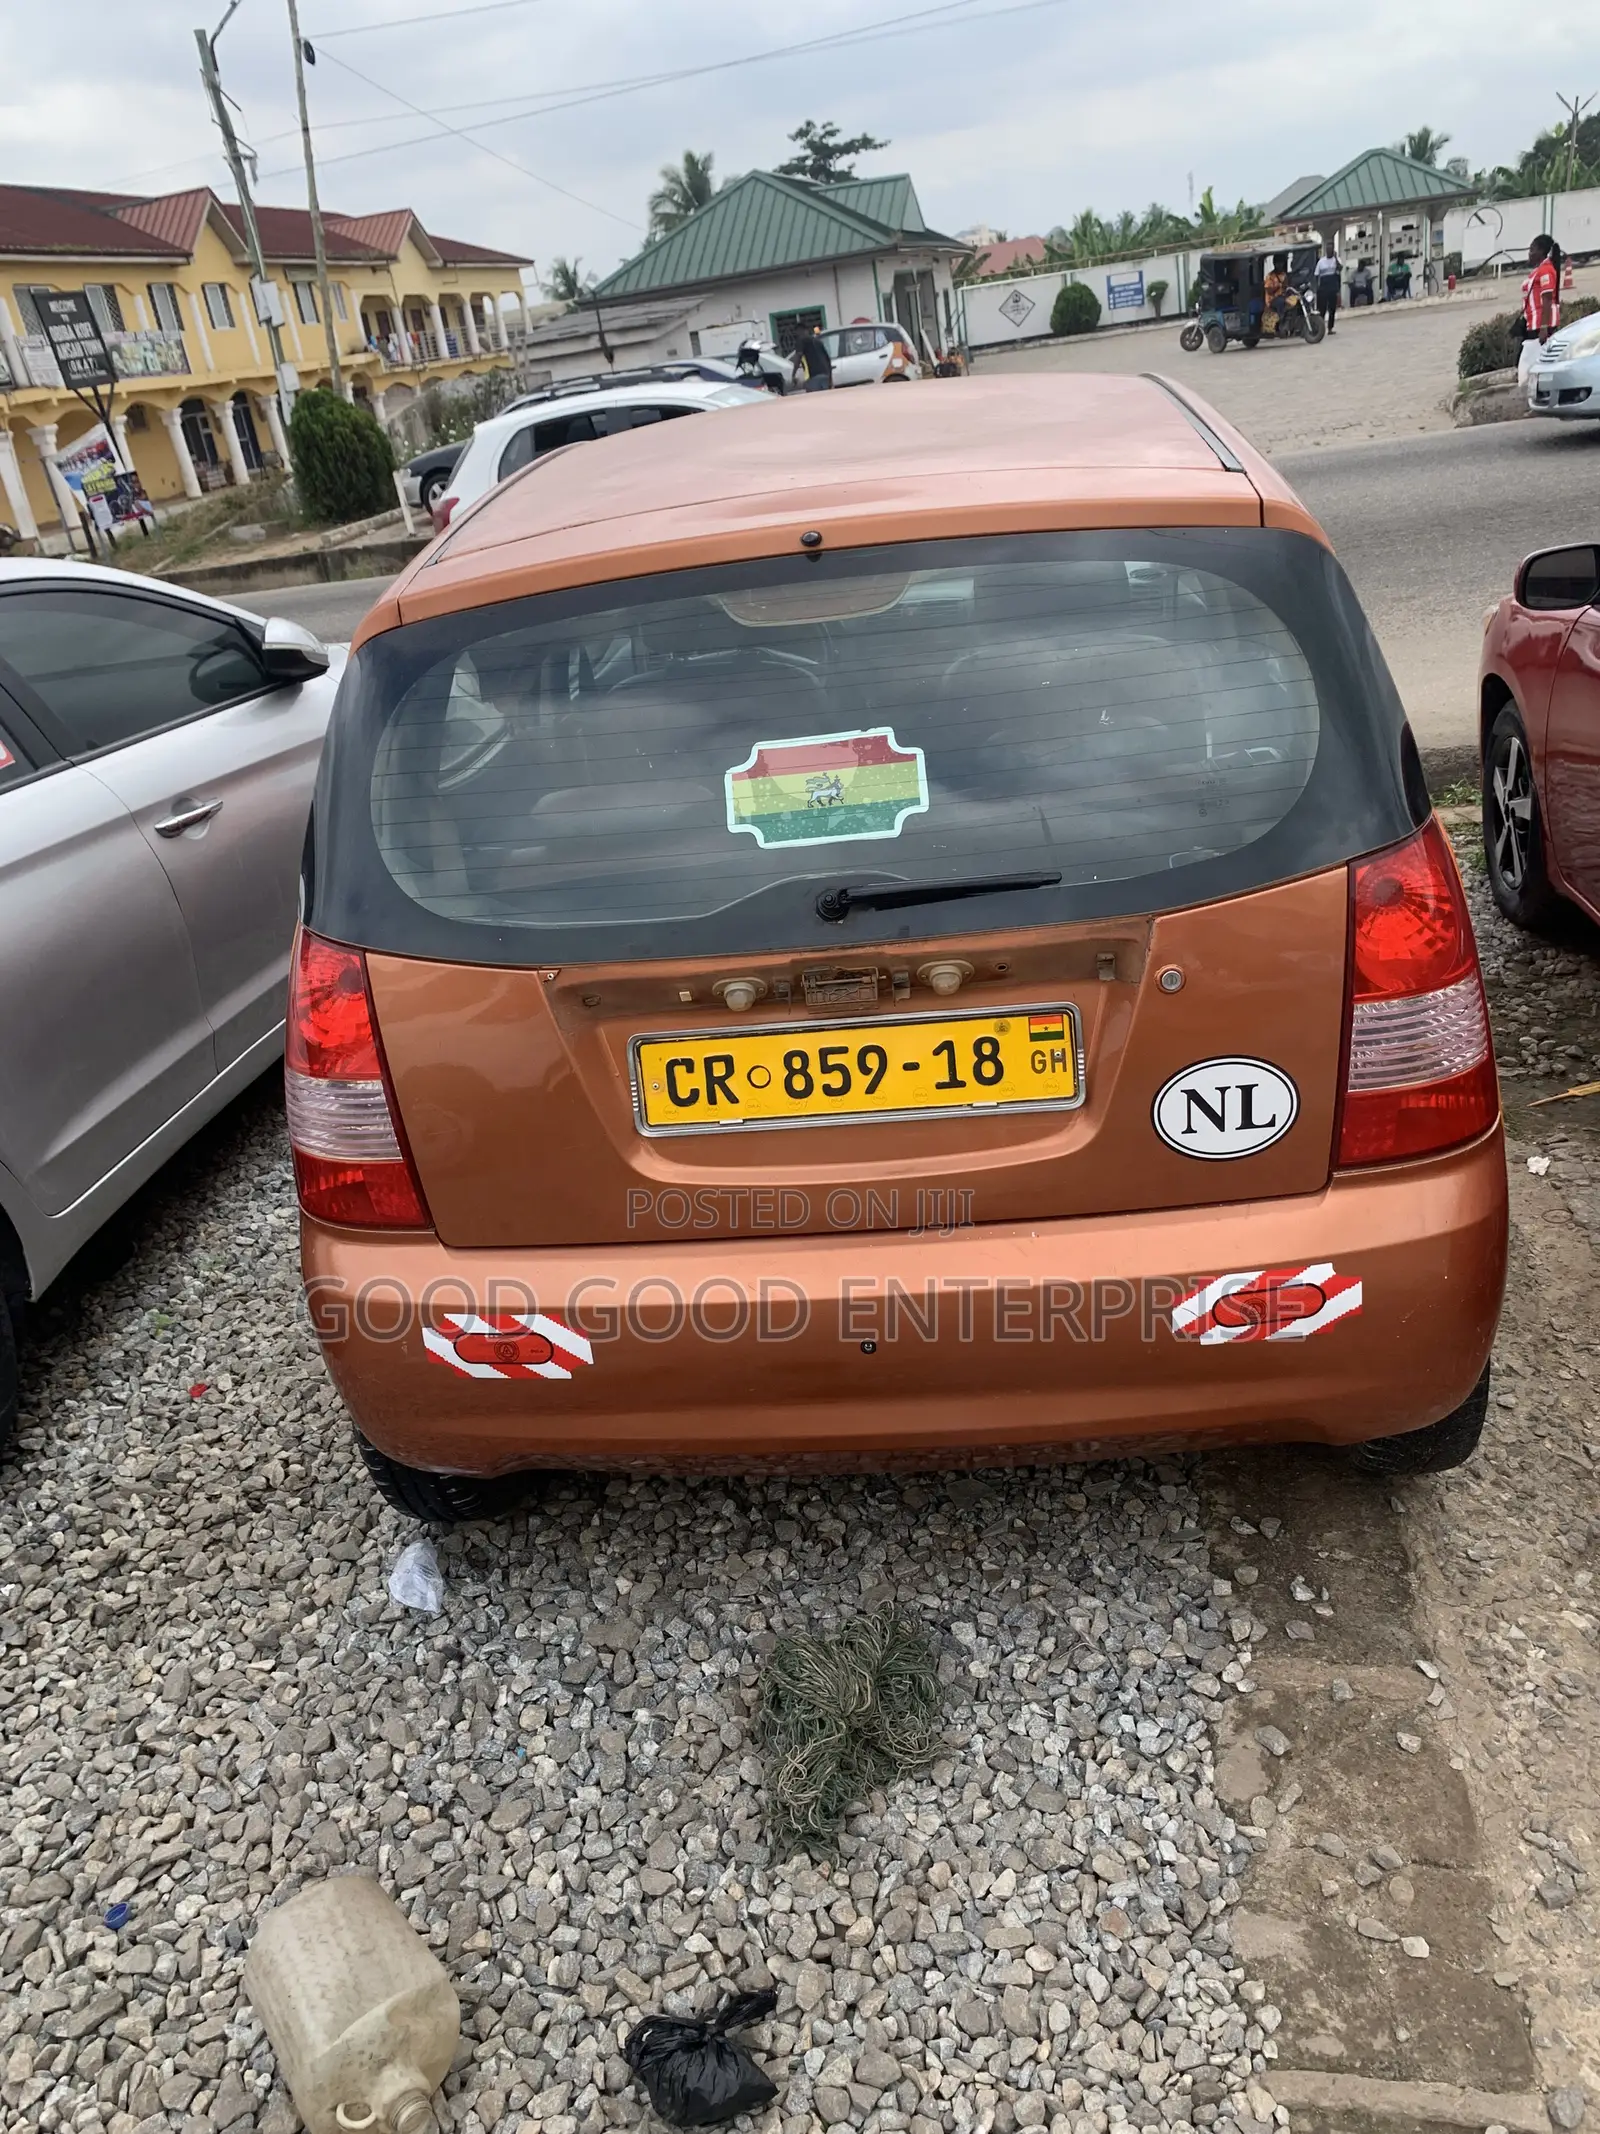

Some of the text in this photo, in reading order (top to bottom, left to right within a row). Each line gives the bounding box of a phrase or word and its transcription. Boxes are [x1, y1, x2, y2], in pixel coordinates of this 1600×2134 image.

[665, 1054, 740, 1107] CR
[1030, 1047, 1067, 1075] GH
[1180, 1083, 1276, 1135] NL
